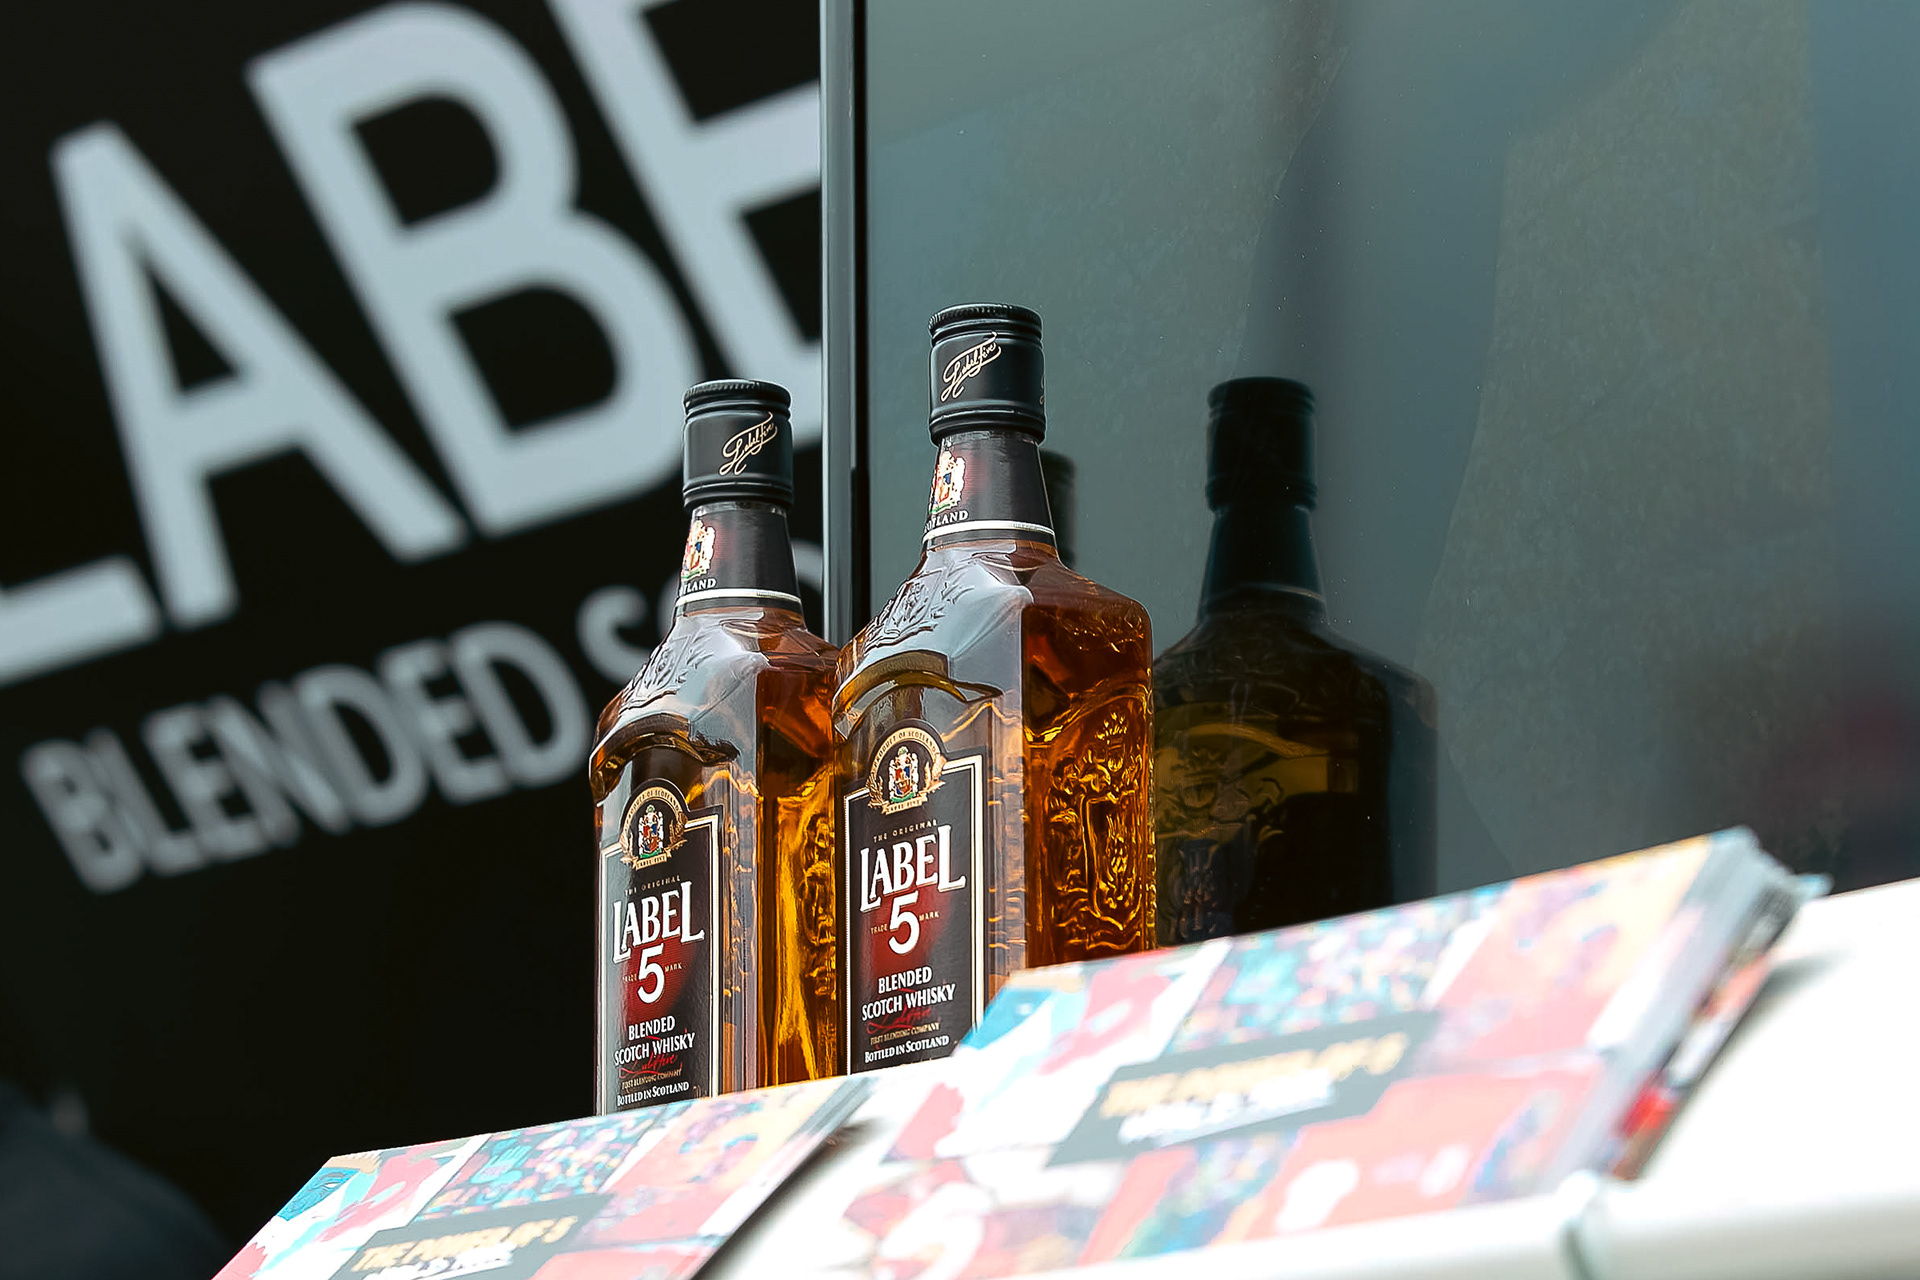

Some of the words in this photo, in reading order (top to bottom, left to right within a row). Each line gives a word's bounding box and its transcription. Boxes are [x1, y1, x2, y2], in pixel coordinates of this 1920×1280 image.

[22, 621, 593, 893] BLENDED
[873, 832, 888, 843] THE
[892, 819, 938, 837] ORIGINAL
[860, 824, 967, 913] LABEL
[624, 887, 637, 897] THE
[641, 875, 681, 891] ORIGINAL
[612, 881, 706, 964] LABEL
[870, 923, 888, 935] TRADE
[888, 889, 921, 955] 5
[919, 910, 940, 922] MARK
[637, 942, 666, 1004] 5
[664, 962, 683, 973] MARK
[878, 966, 933, 994] BLENDED
[861, 995, 903, 1021] SCOTCH
[905, 983, 956, 1009] WHISKY
[628, 1015, 676, 1041] BLENDED
[884, 1028, 910, 1042] BLENDING
[911, 1021, 940, 1035] COMPANY
[614, 1042, 650, 1066] SCOTCH
[652, 1032, 696, 1056] WHISKY
[864, 1046, 895, 1063] BOTTLED
[895, 1044, 905, 1056] IN
[905, 1035, 950, 1053] SCOTLAND
[656, 1068, 682, 1081] COMPANY
[616, 1091, 643, 1107] BOTTLED
[643, 1090, 652, 1100] IN
[651, 1081, 690, 1098] SCOTLAND
